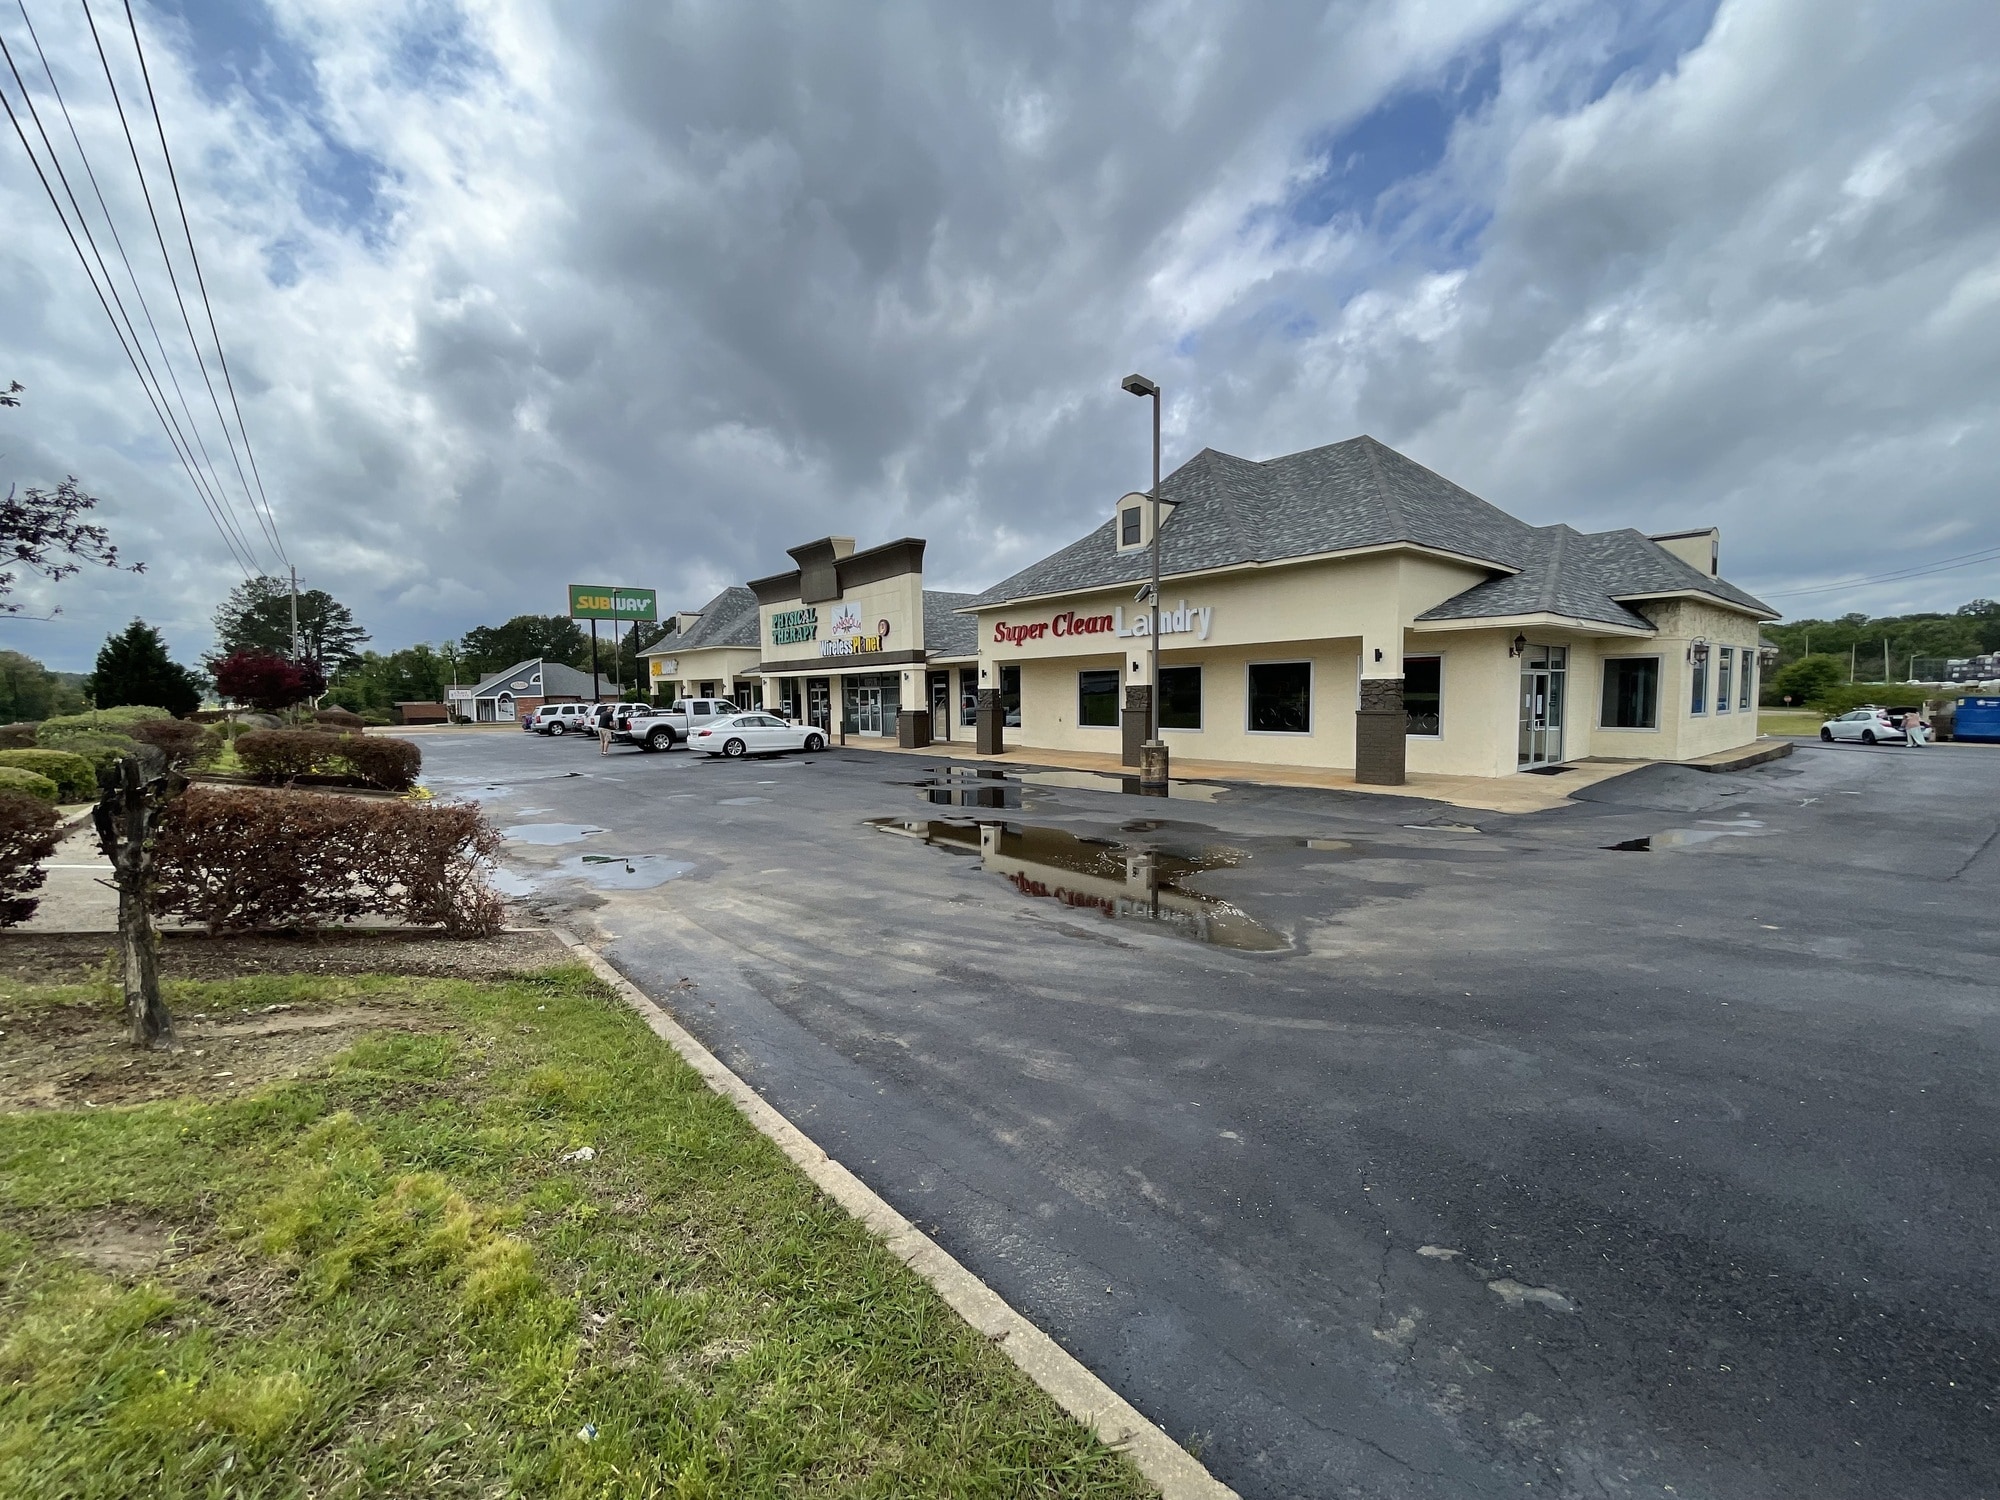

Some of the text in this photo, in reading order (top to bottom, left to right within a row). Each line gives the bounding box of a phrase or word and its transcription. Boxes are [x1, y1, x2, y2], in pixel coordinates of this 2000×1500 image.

[576, 595, 652, 612] SUBWAY
[771, 608, 817, 629] PHYSICAL
[994, 621, 1048, 646] Super
[1051, 611, 1114, 637] Clean
[771, 625, 817, 645] THERAPY
